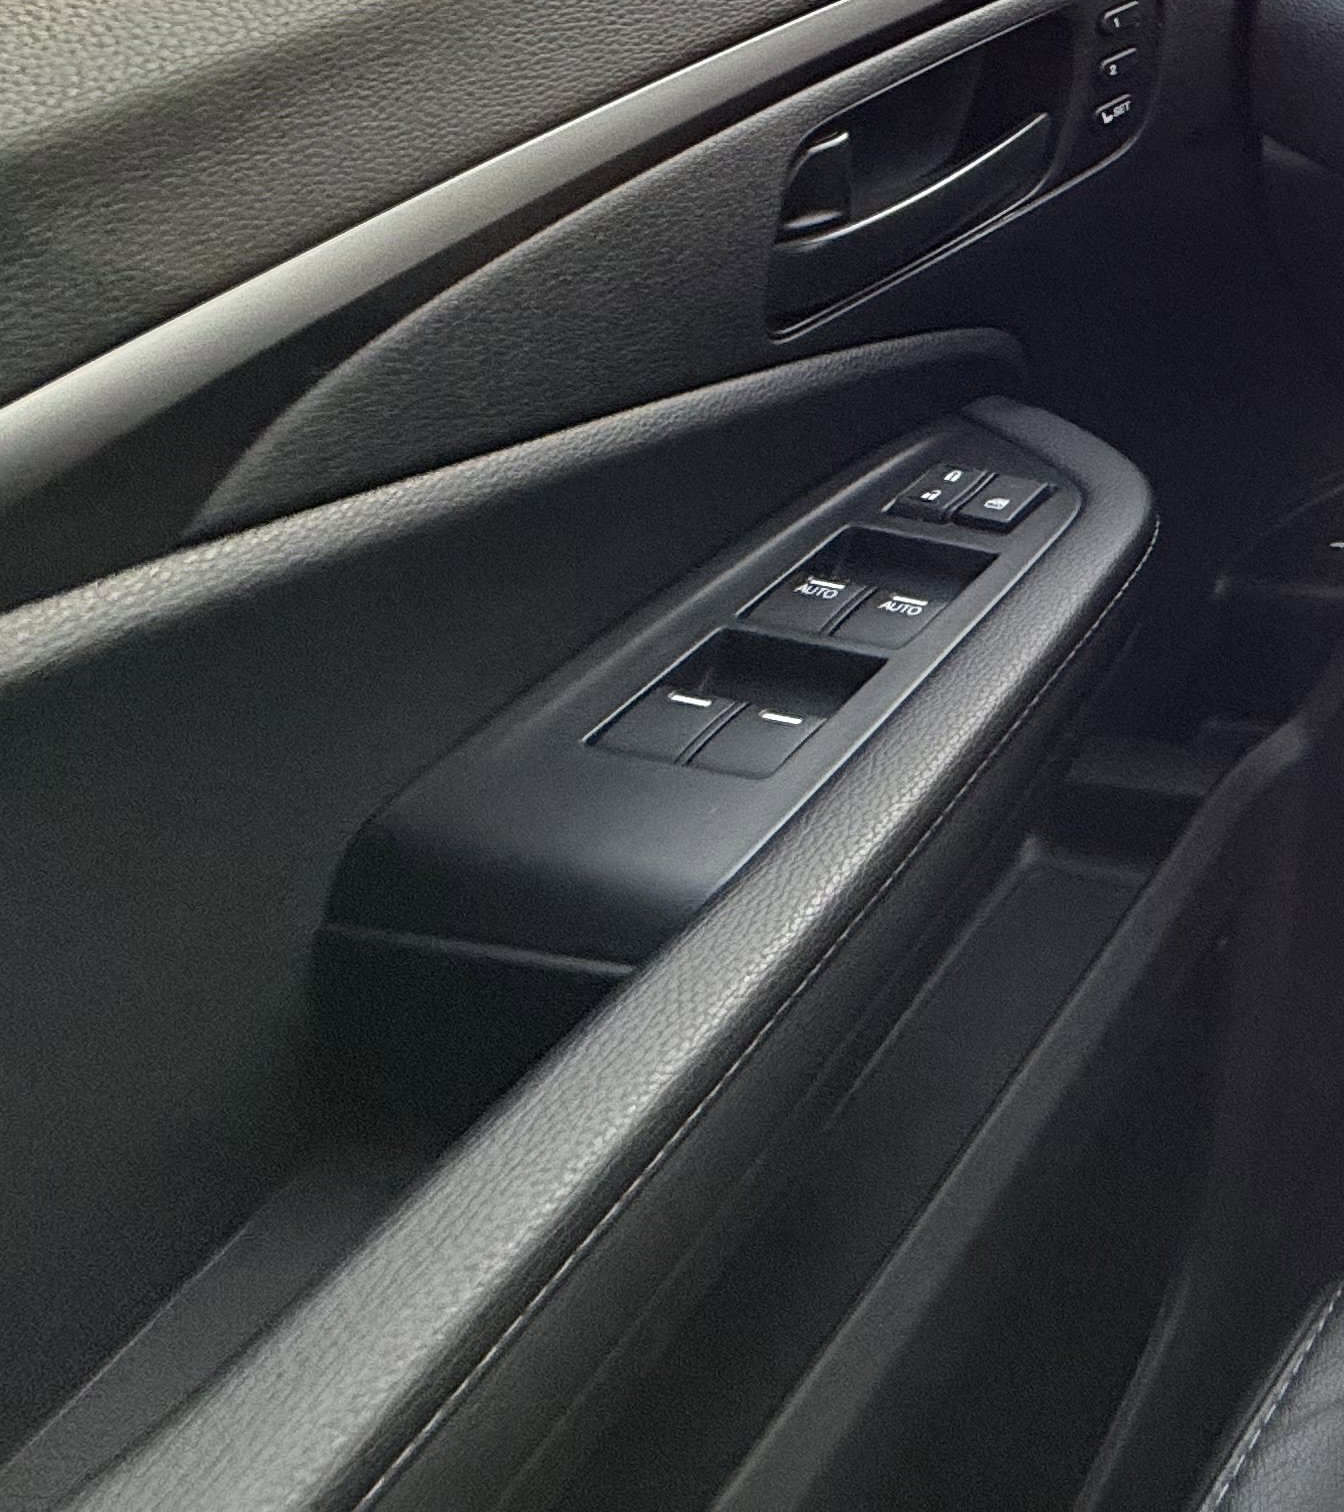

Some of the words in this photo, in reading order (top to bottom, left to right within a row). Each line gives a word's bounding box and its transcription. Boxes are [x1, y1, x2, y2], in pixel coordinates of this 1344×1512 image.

[1113, 16, 1120, 28] 1
[1113, 100, 1132, 118] SET
[794, 583, 839, 599] AUTO
[878, 600, 923, 616] AUTO
